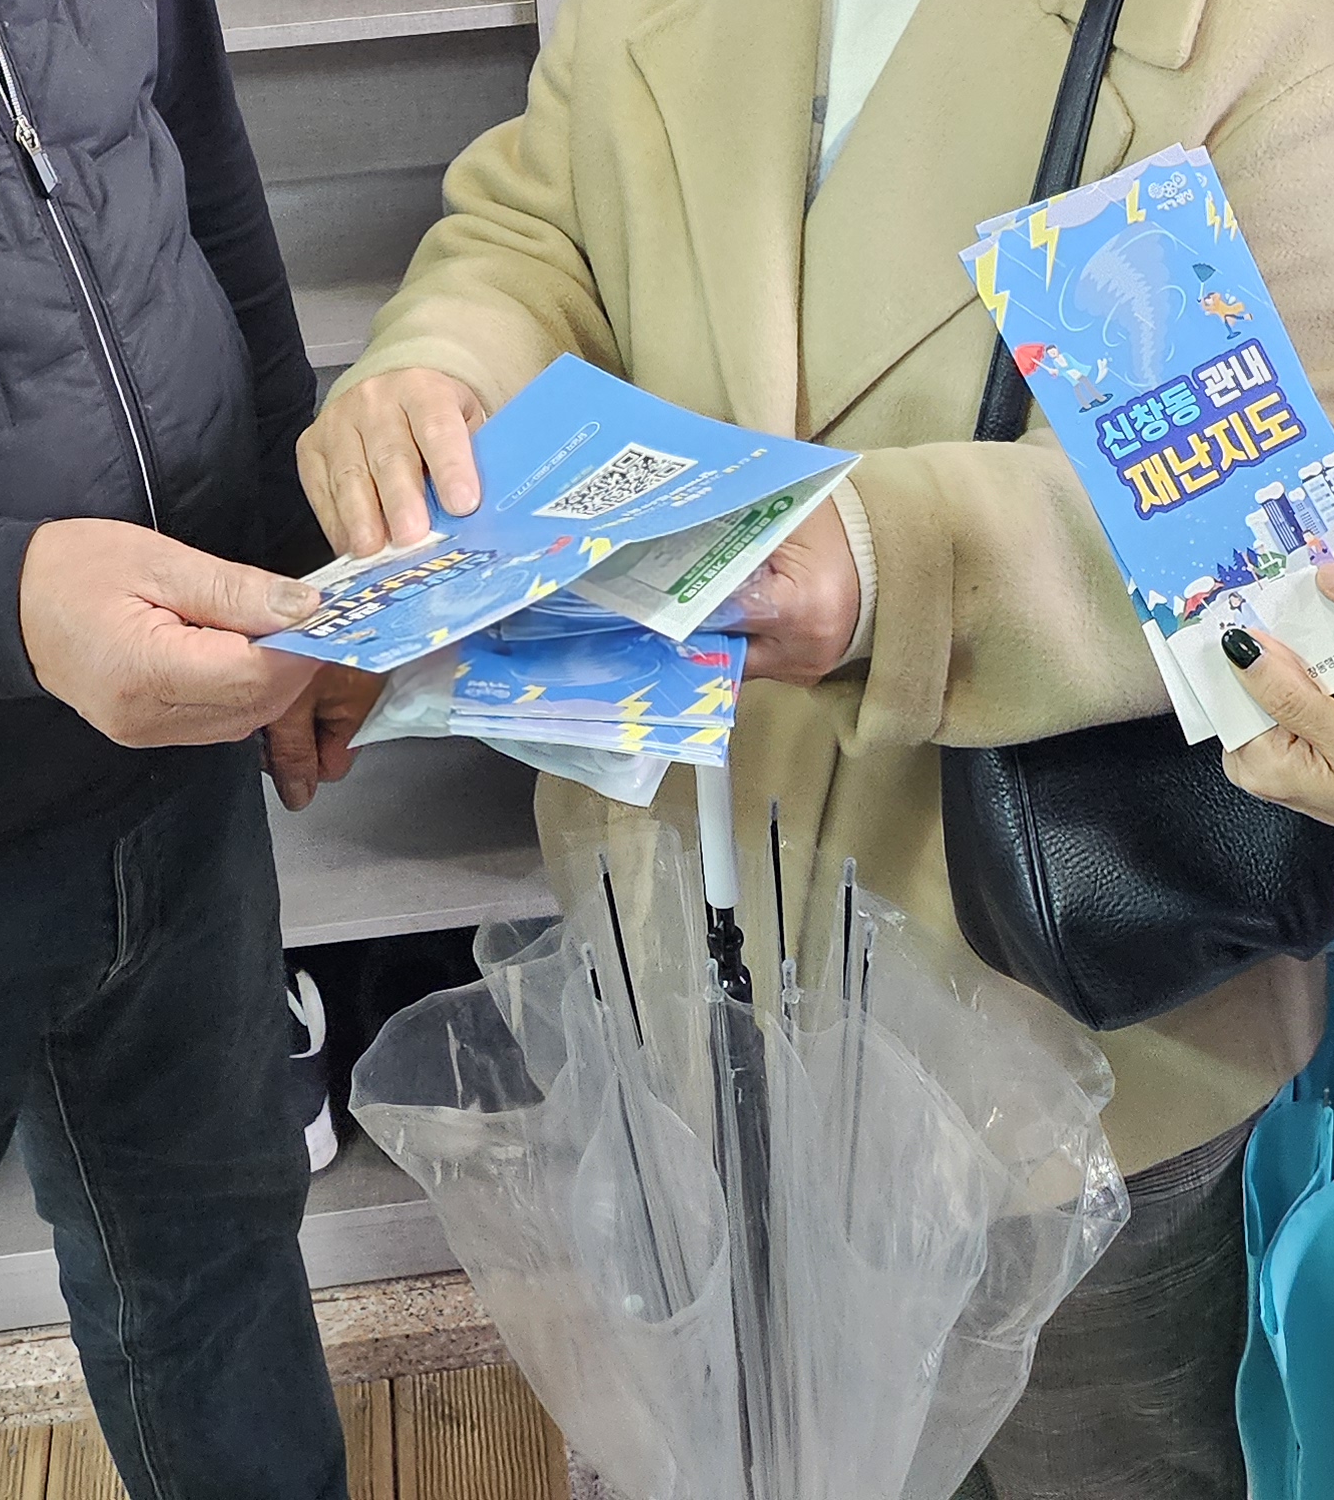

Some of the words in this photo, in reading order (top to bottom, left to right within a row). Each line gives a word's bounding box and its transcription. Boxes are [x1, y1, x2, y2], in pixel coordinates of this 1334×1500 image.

[1101, 381, 1202, 460] 신창동
[1197, 345, 1273, 409] 관내
[1123, 392, 1301, 513] 재난지도
